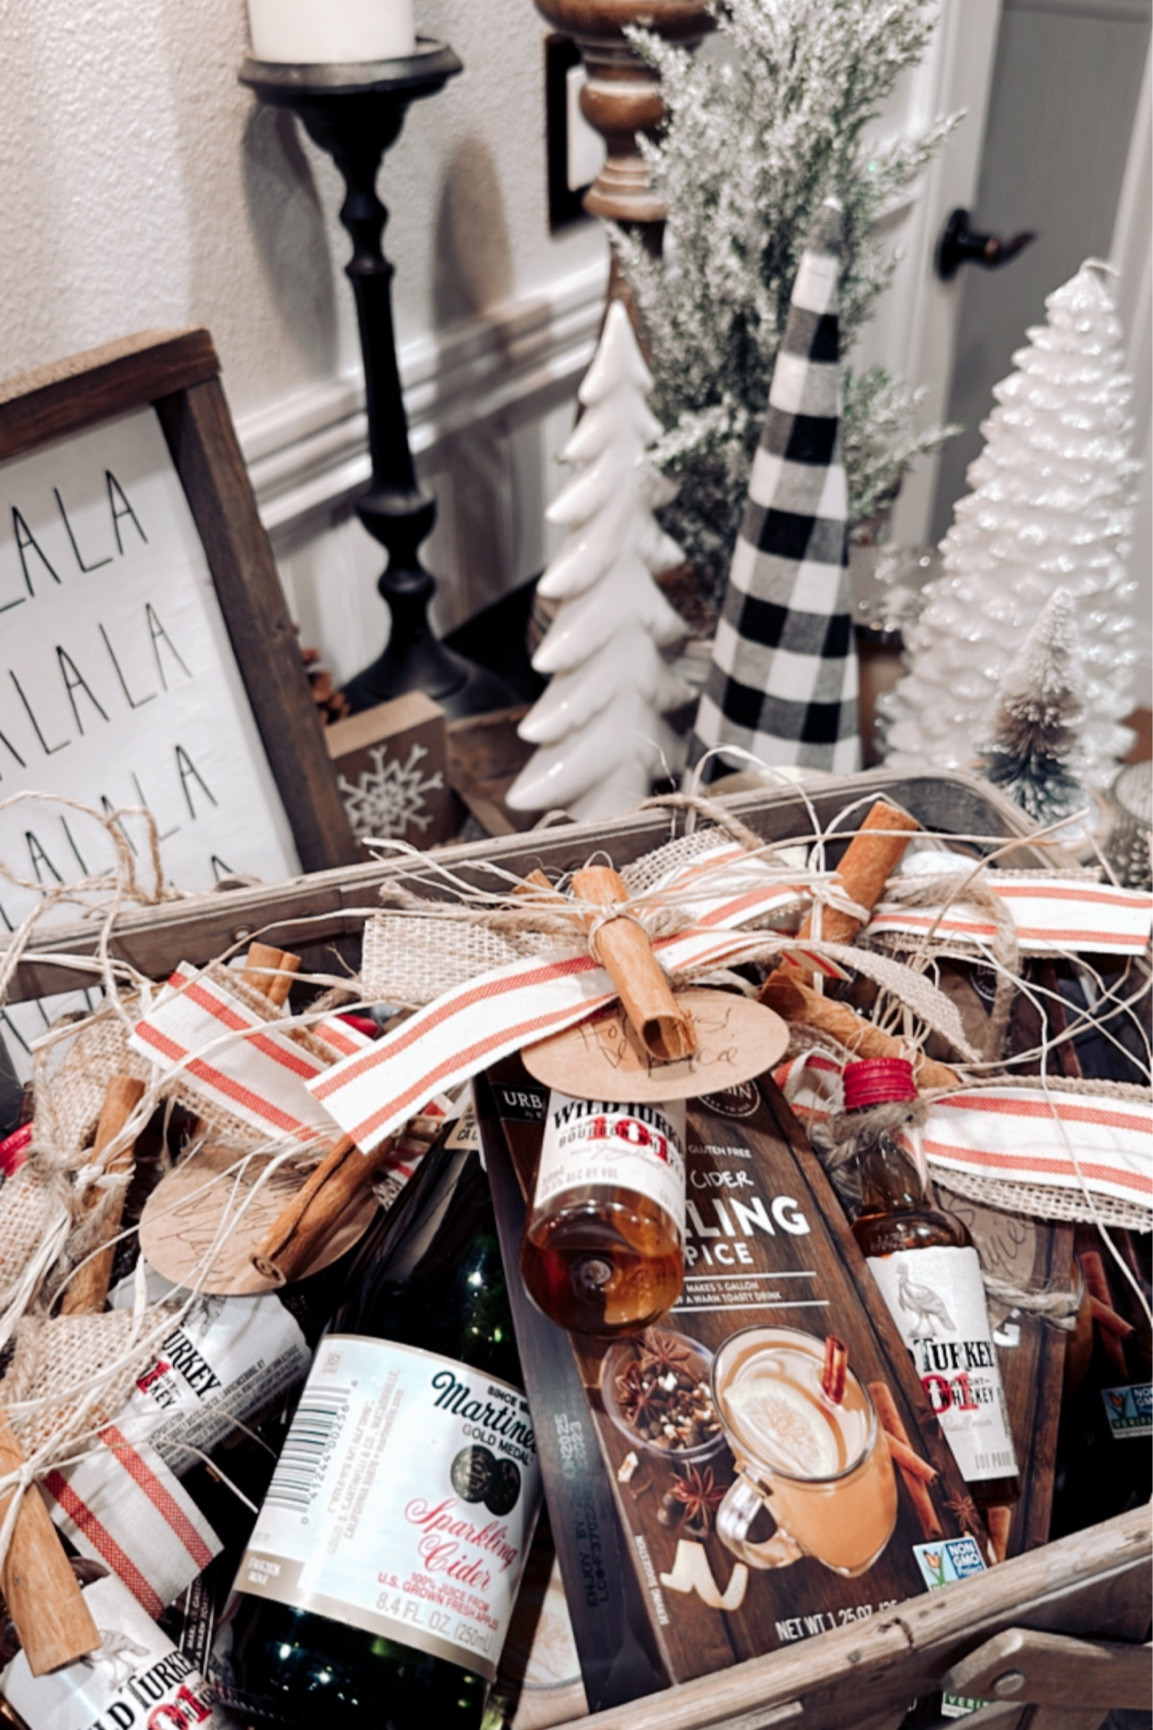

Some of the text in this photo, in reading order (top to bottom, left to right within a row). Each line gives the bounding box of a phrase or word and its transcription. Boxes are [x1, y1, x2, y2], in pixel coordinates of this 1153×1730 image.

[0, 470, 149, 613] ALA
[586, 1115, 673, 1169] 101
[728, 1146, 752, 1159] FREE
[690, 1169, 754, 1190] CIDER
[724, 1281, 759, 1291] GALLON
[913, 1337, 995, 1373] TURKEY
[462, 1423, 530, 1468] GOLD MEDAL
[404, 1498, 518, 1574] Sparkling
[950, 1543, 975, 1555] NON
[417, 1533, 492, 1593] Cider
[953, 1554, 980, 1567] GMO
[376, 1592, 402, 1615] 8.4
[377, 1571, 399, 1589] U.S.
[402, 1579, 446, 1606] GROWN
[445, 1597, 477, 1618] FRESH
[437, 1582, 468, 1599] JUICE
[468, 1594, 490, 1613] FROM
[775, 1617, 803, 1641] NET
[804, 1613, 826, 1636] WT
